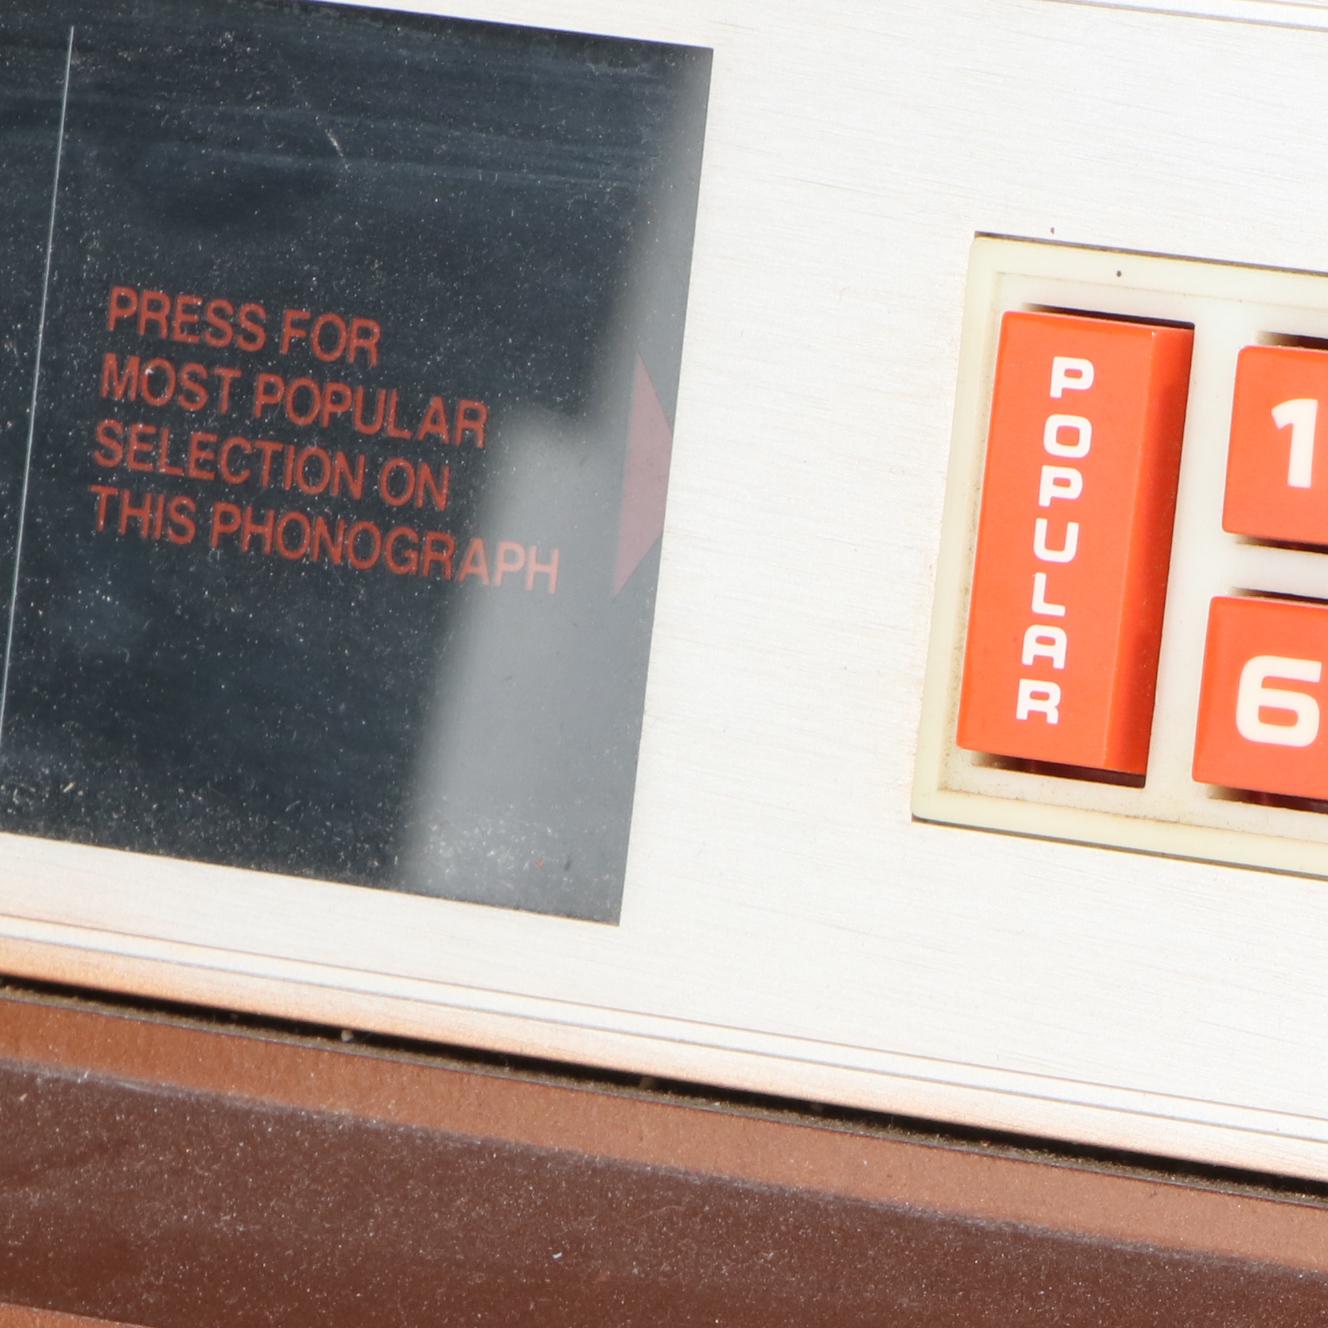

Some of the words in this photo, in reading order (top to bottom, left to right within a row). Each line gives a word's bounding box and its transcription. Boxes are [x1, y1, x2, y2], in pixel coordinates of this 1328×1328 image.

[106, 286, 268, 353] PRESS
[279, 310, 382, 368] FOR
[100, 353, 243, 413] MOST
[253, 373, 488, 449] POPULAR
[1270, 397, 1320, 490] 1
[92, 420, 368, 501] SELECTION
[379, 459, 452, 512] ON
[89, 485, 197, 546] THIS
[209, 501, 560, 596] PHONOGRAPH
[1014, 355, 1096, 727] POPULAR
[1233, 654, 1323, 749] 6
